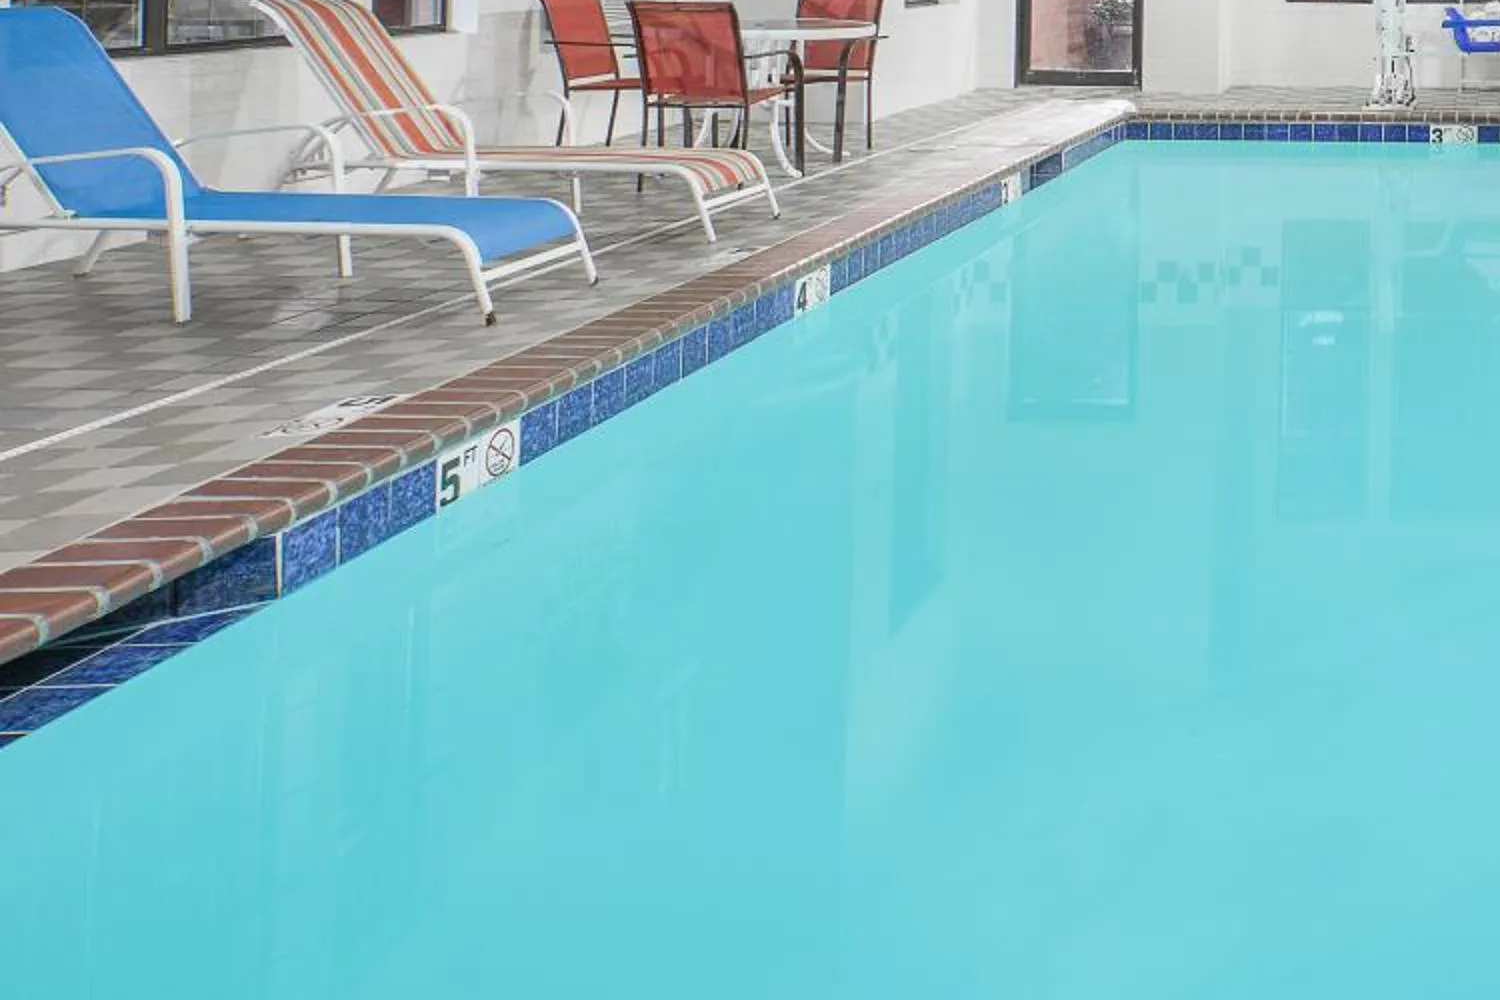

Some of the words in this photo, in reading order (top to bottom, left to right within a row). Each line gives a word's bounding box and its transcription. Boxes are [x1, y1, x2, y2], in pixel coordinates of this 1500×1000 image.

[1432, 127, 1443, 143] 3
[440, 456, 460, 507] 5
[463, 445, 478, 467] FT
